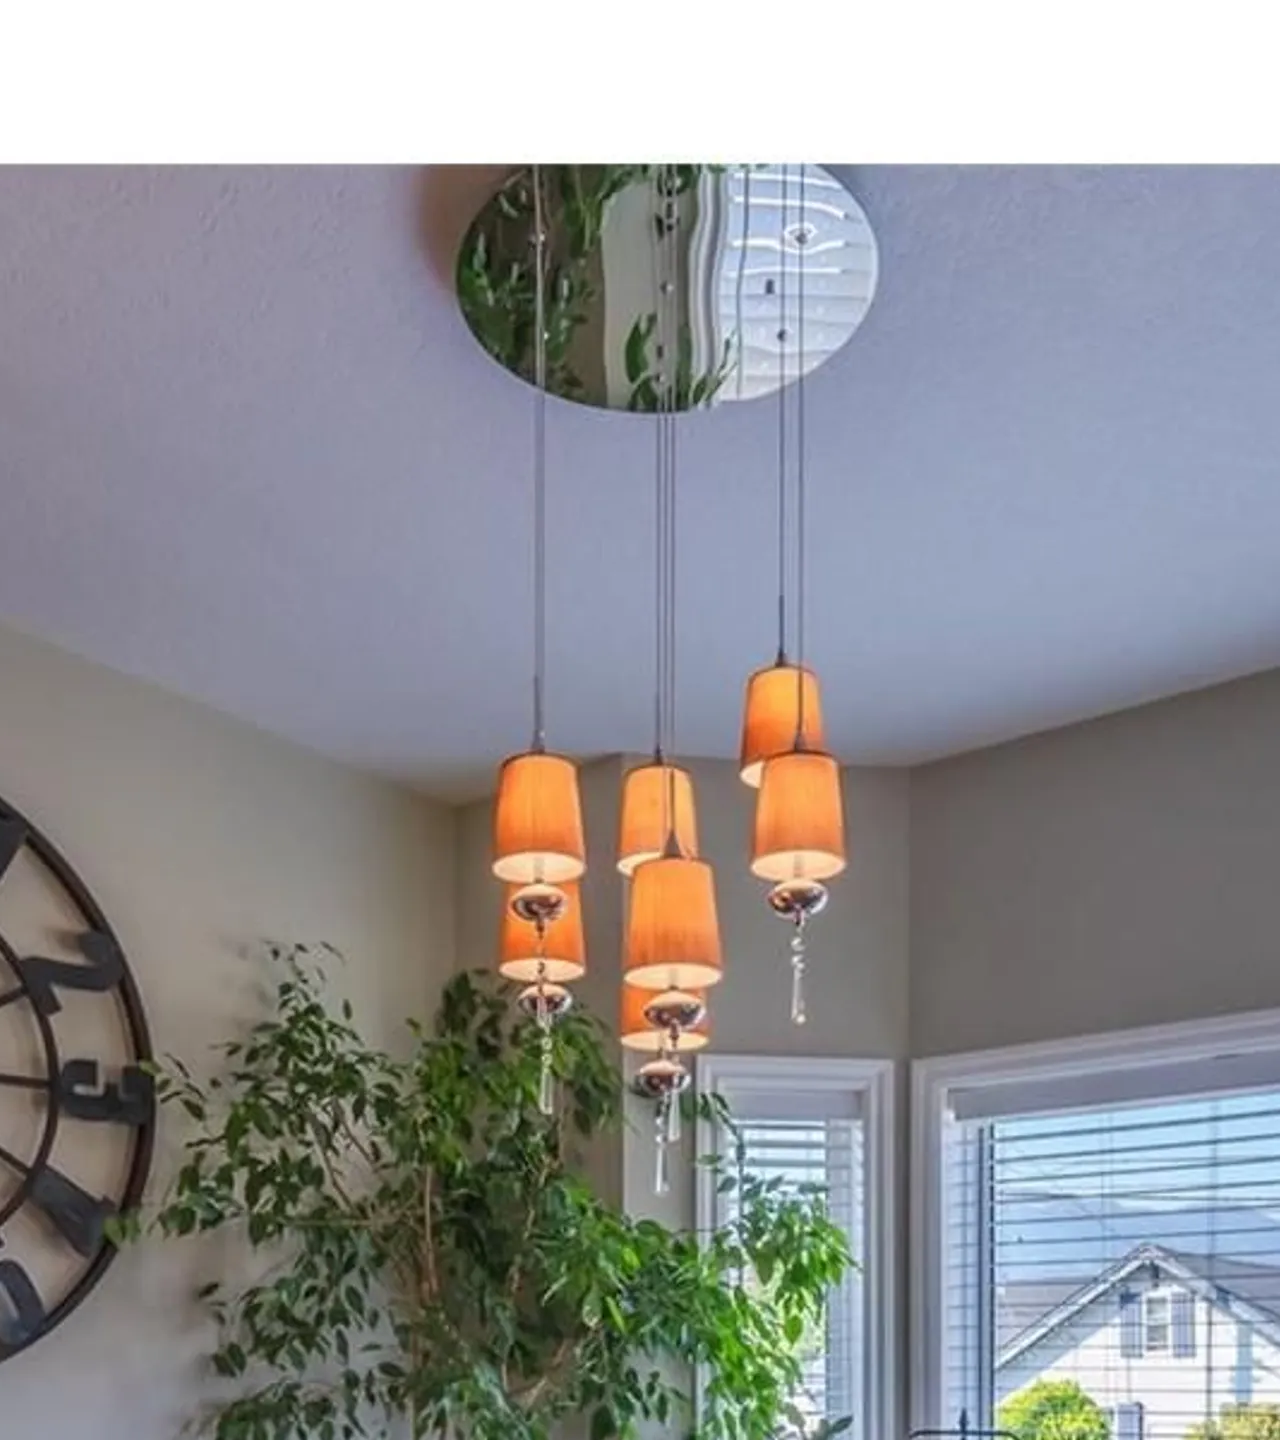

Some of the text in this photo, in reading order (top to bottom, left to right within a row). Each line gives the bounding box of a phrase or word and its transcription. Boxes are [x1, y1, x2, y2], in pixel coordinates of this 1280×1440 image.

[18, 931, 123, 1015] 2
[58, 1057, 151, 1127] 3
[27, 1164, 128, 1257] 4
